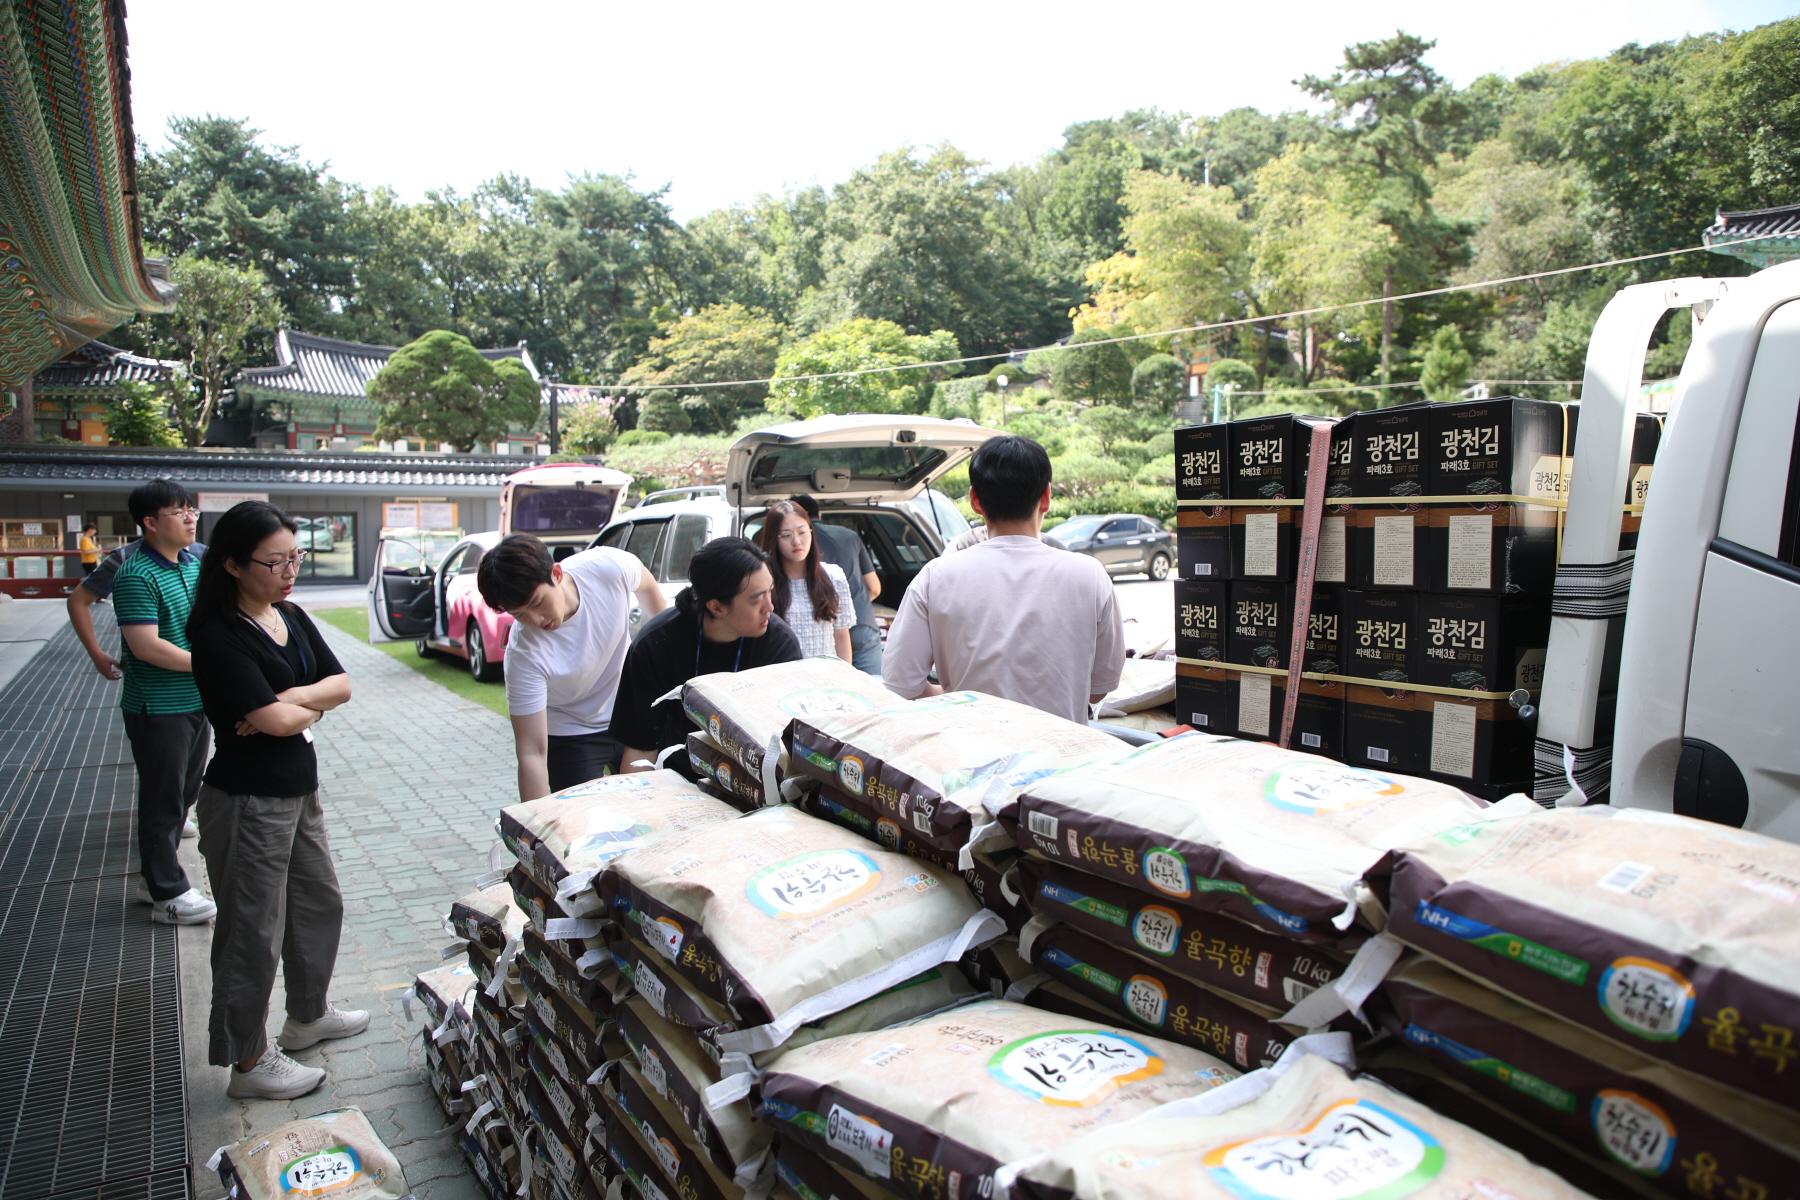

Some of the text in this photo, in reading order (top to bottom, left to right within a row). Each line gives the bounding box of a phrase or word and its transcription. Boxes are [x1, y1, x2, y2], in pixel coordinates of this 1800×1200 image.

[1240, 437, 1283, 466] 광천김
[1366, 431, 1419, 463] 광천김
[1441, 425, 1499, 459] 광천김
[1182, 449, 1221, 476] 광천김
[1240, 467, 1282, 477] 파래3호 GIFT SET
[1366, 463, 1419, 476] 파래3호 GIFT SET
[1440, 459, 1499, 473] 파래3호 GIFT SET
[1182, 477, 1203, 487] 파래3호
[1181, 604, 1217, 629] 광천김
[1236, 601, 1278, 627] 광천김
[1181, 628, 1200, 638] 파래3호
[1236, 626, 1277, 638] 파래3호 GIFT SET
[1356, 620, 1406, 649] 광천김
[1427, 618, 1485, 650] 광천김
[1356, 648, 1406, 662] 파래3호 GIFT SET
[1427, 648, 1484, 662] 파래3호 GIFT SET
[843, 764, 861, 785] 한수위
[866, 776, 898, 811] 율곡향
[1082, 836, 1139, 875] 율곡향
[1150, 861, 1183, 890] 한수위
[1044, 885, 1059, 897] NH
[1141, 914, 1173, 944] 한수위
[1422, 908, 1450, 928] NH
[1145, 936, 1163, 950] 파주쌀
[1183, 930, 1253, 977] 율곡향
[1132, 985, 1160, 1016] 한수위
[1617, 972, 1676, 1019] 한수위
[1170, 1005, 1231, 1055] 율곡향
[1023, 1042, 1136, 1091] 한수위
[294, 1161, 349, 1184] 한수위
